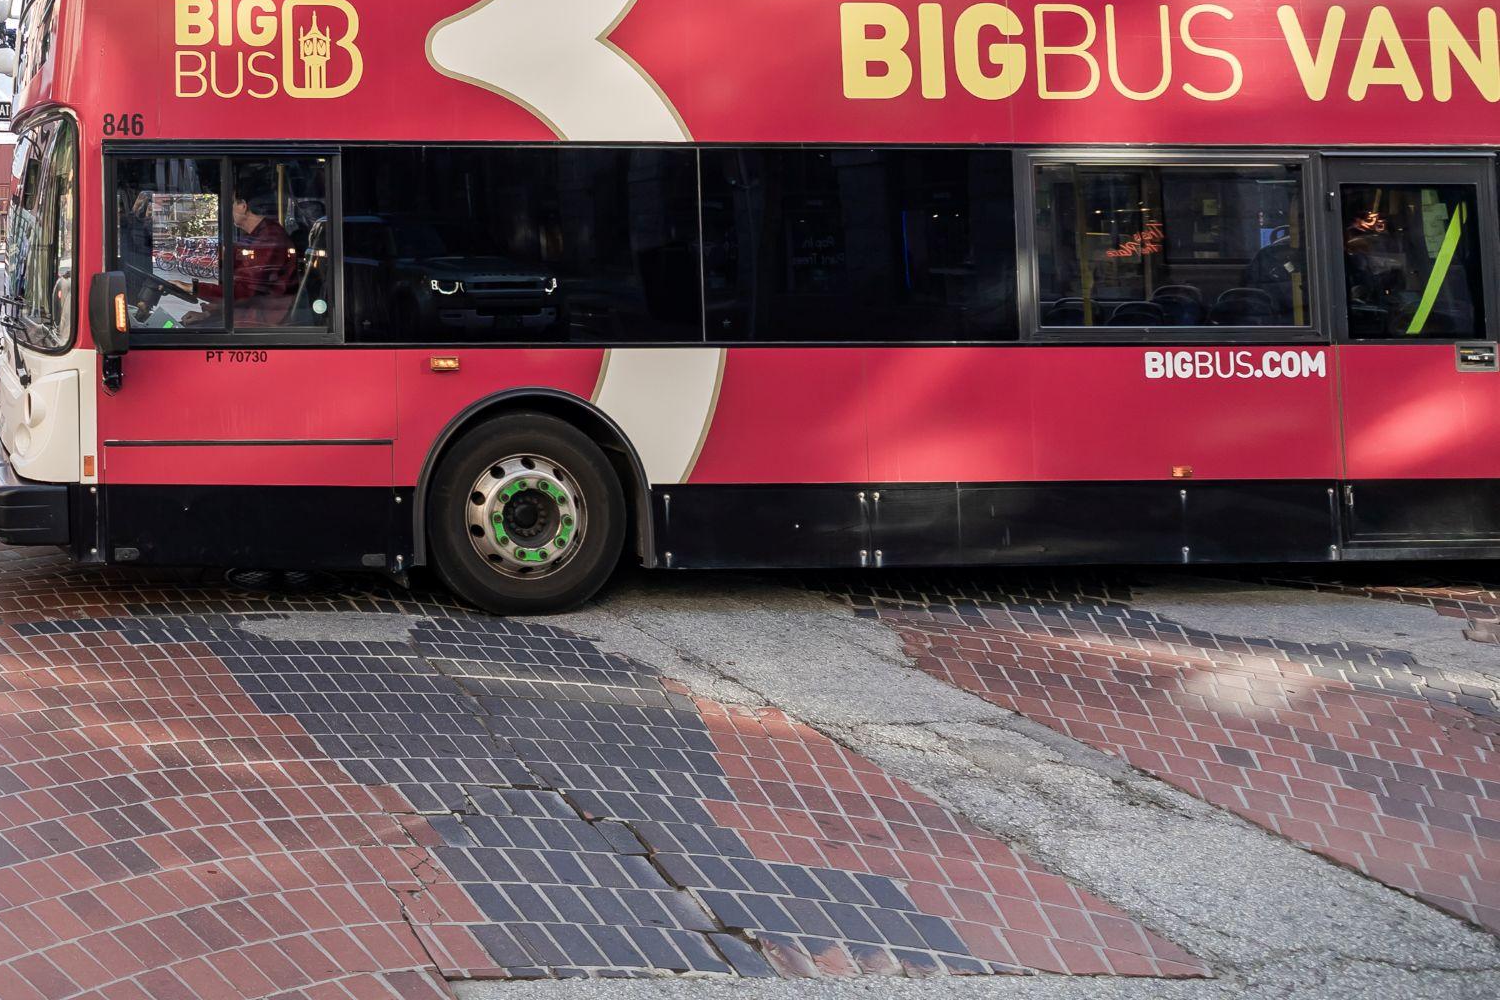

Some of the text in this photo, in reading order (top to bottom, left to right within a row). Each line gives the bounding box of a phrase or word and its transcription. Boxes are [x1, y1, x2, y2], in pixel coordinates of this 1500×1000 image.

[1276, 4, 1500, 103] VAN
[175, 50, 279, 99] BUS
[102, 113, 144, 136] 846
[205, 350, 268, 363] PT 70730
[1144, 350, 1326, 379] BIGBUS.COM
